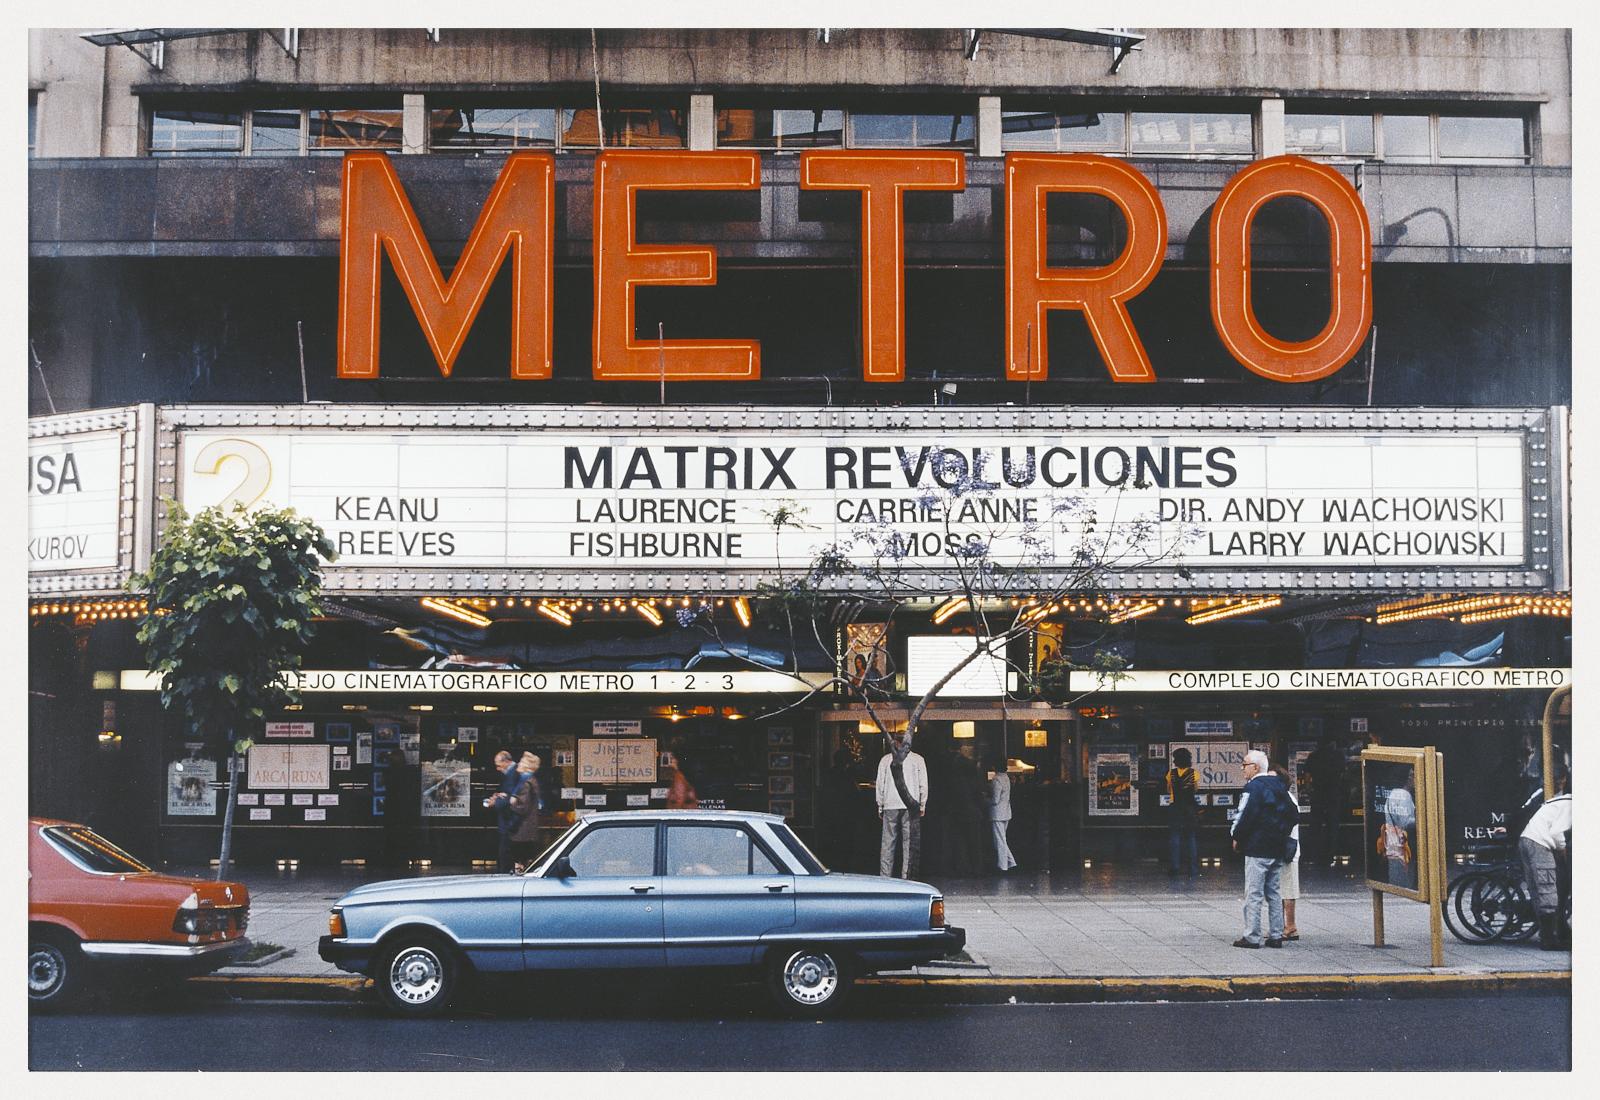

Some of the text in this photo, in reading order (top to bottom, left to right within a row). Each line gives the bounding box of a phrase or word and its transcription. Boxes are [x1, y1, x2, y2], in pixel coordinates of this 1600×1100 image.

[337, 150, 1373, 383] METRO
[564, 446, 1236, 490] MATRIX REVOLUCIONES
[335, 496, 438, 522] KEANU
[576, 498, 736, 523] LAURENCE
[836, 498, 1038, 523] CARRIE ANNE
[1160, 498, 1504, 522] DIR. ANDY WACHOWSKI
[338, 531, 456, 557] REEVES
[570, 532, 742, 558] FISHBURNE
[1208, 531, 1504, 556] LARRY WACHOWSKI
[344, 674, 547, 690] CINEMATOGRAFICO
[560, 674, 634, 690] METRO
[684, 675, 696, 690] 2
[722, 675, 734, 690] 3
[1169, 670, 1564, 689] COMPLEJO CINEMATOGRAFICO METRO
[593, 743, 641, 755] JINETE
[1196, 746, 1244, 764] LUNES
[583, 765, 653, 777] BALLENAS
[1203, 766, 1232, 784] SOL
